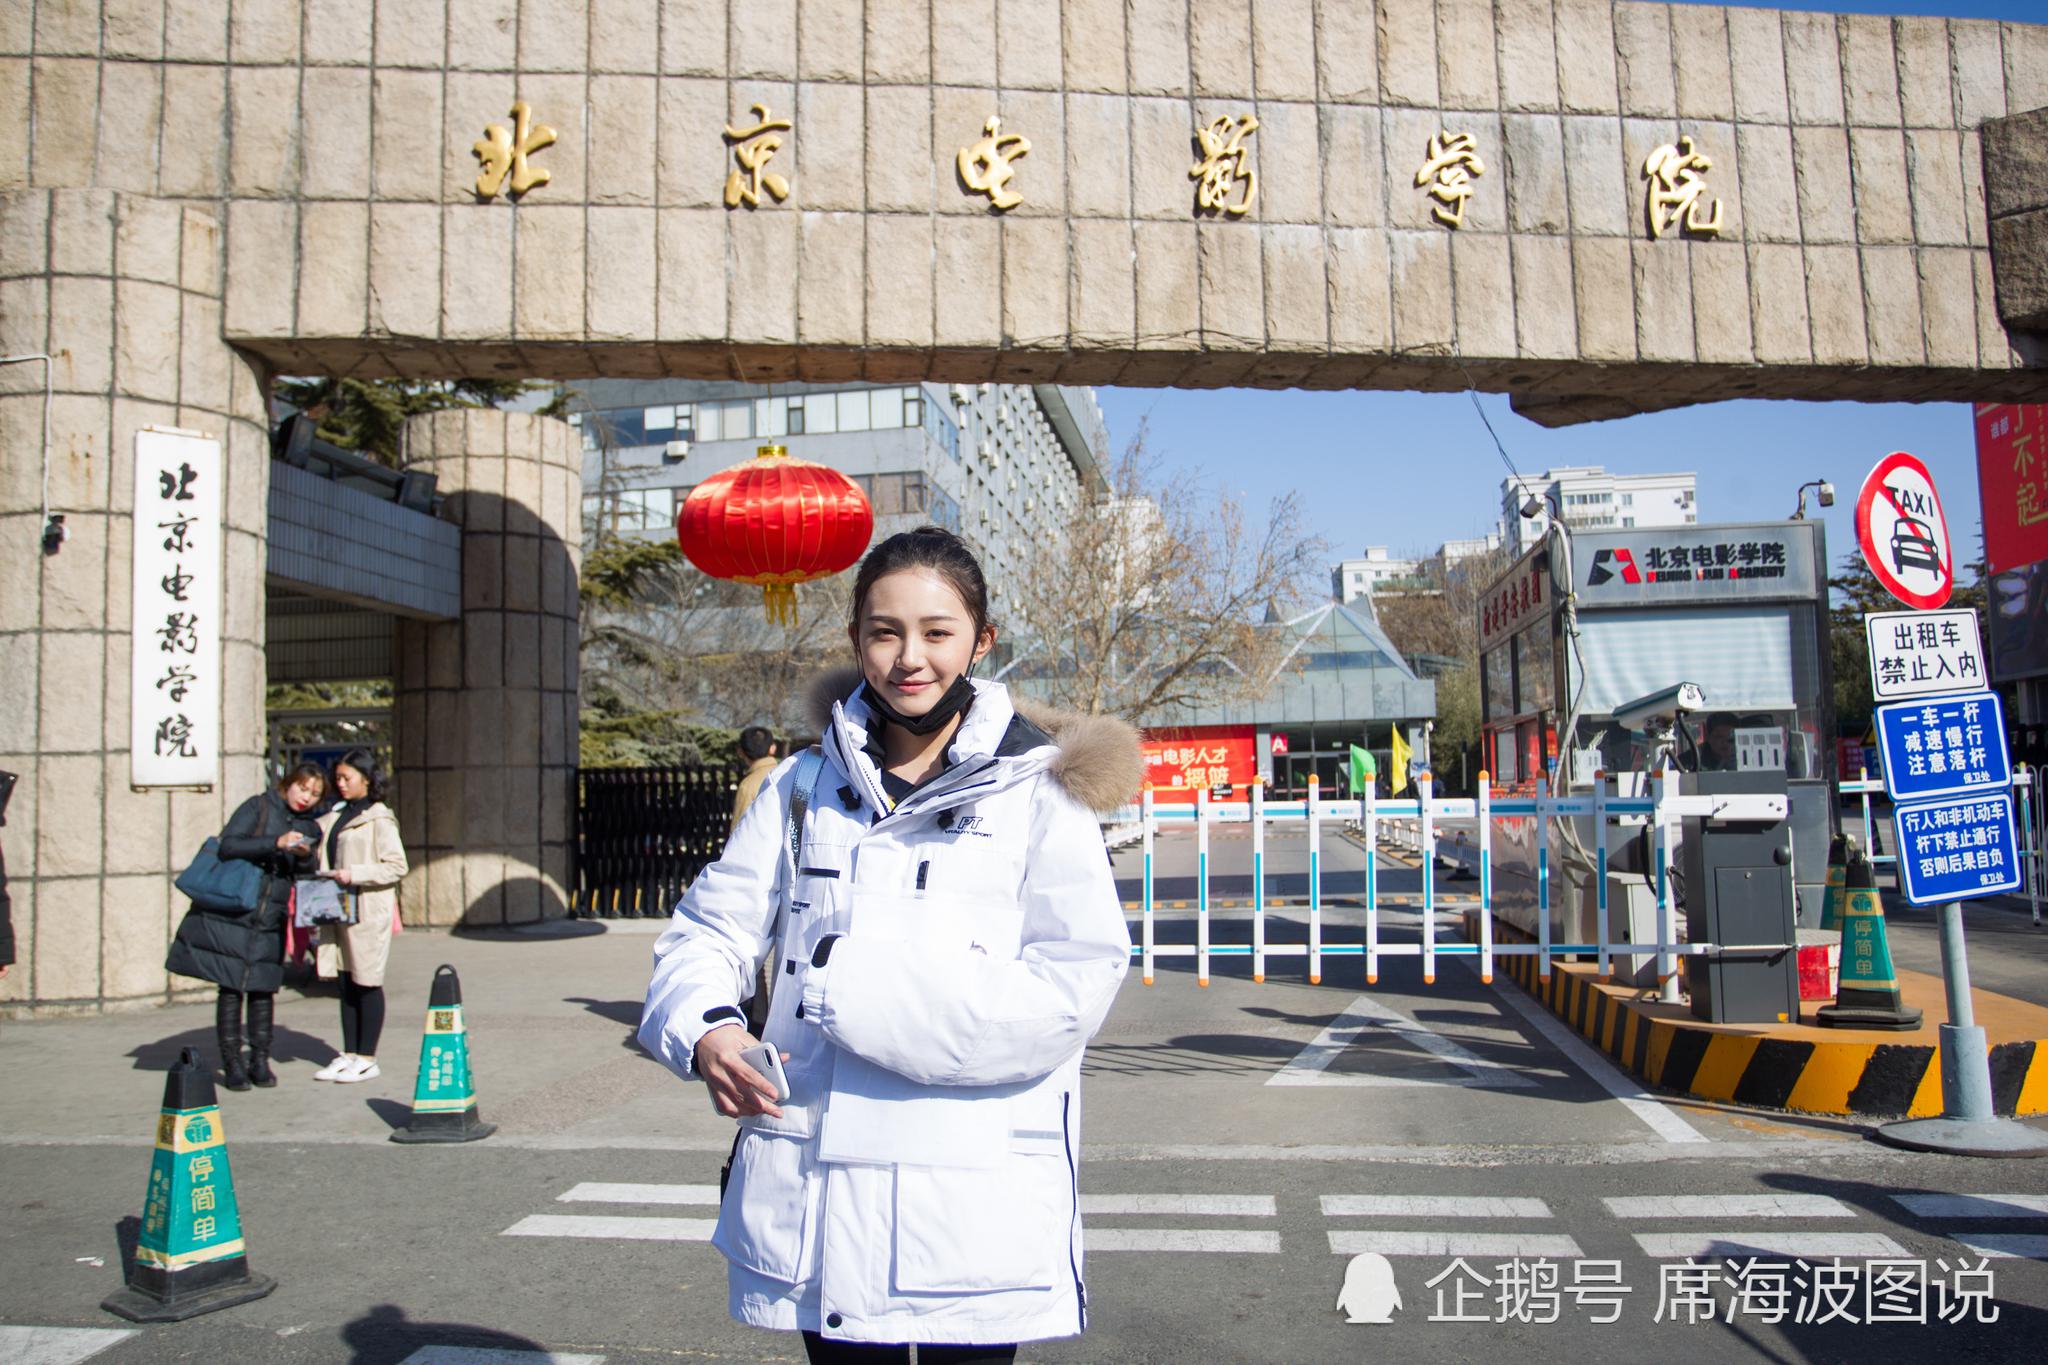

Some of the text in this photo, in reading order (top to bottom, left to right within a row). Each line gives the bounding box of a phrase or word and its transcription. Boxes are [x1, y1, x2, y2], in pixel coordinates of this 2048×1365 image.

[472, 102, 1723, 238] 北京电影学院
[1886, 486, 1934, 518] TAXI
[1645, 542, 1786, 569] 北京电影学院
[154, 462, 199, 757] 北京电影学院
[1894, 620, 1961, 650] 出租车
[1880, 650, 1978, 685] 禁止入内
[1901, 702, 1980, 728] 一车一杆
[1904, 725, 1983, 753] 减速慢行
[1908, 747, 1986, 776] 注意落杆
[1963, 770, 1991, 784] 保卫处
[1905, 802, 2005, 833] 行人和非机动车
[1916, 825, 2000, 854] 杆下禁止通行
[1920, 850, 2004, 878] 否则后果自负
[1979, 872, 2005, 886] 保卫处
[1854, 919, 1873, 976] 停简单
[188, 1155, 217, 1242] 停简单
